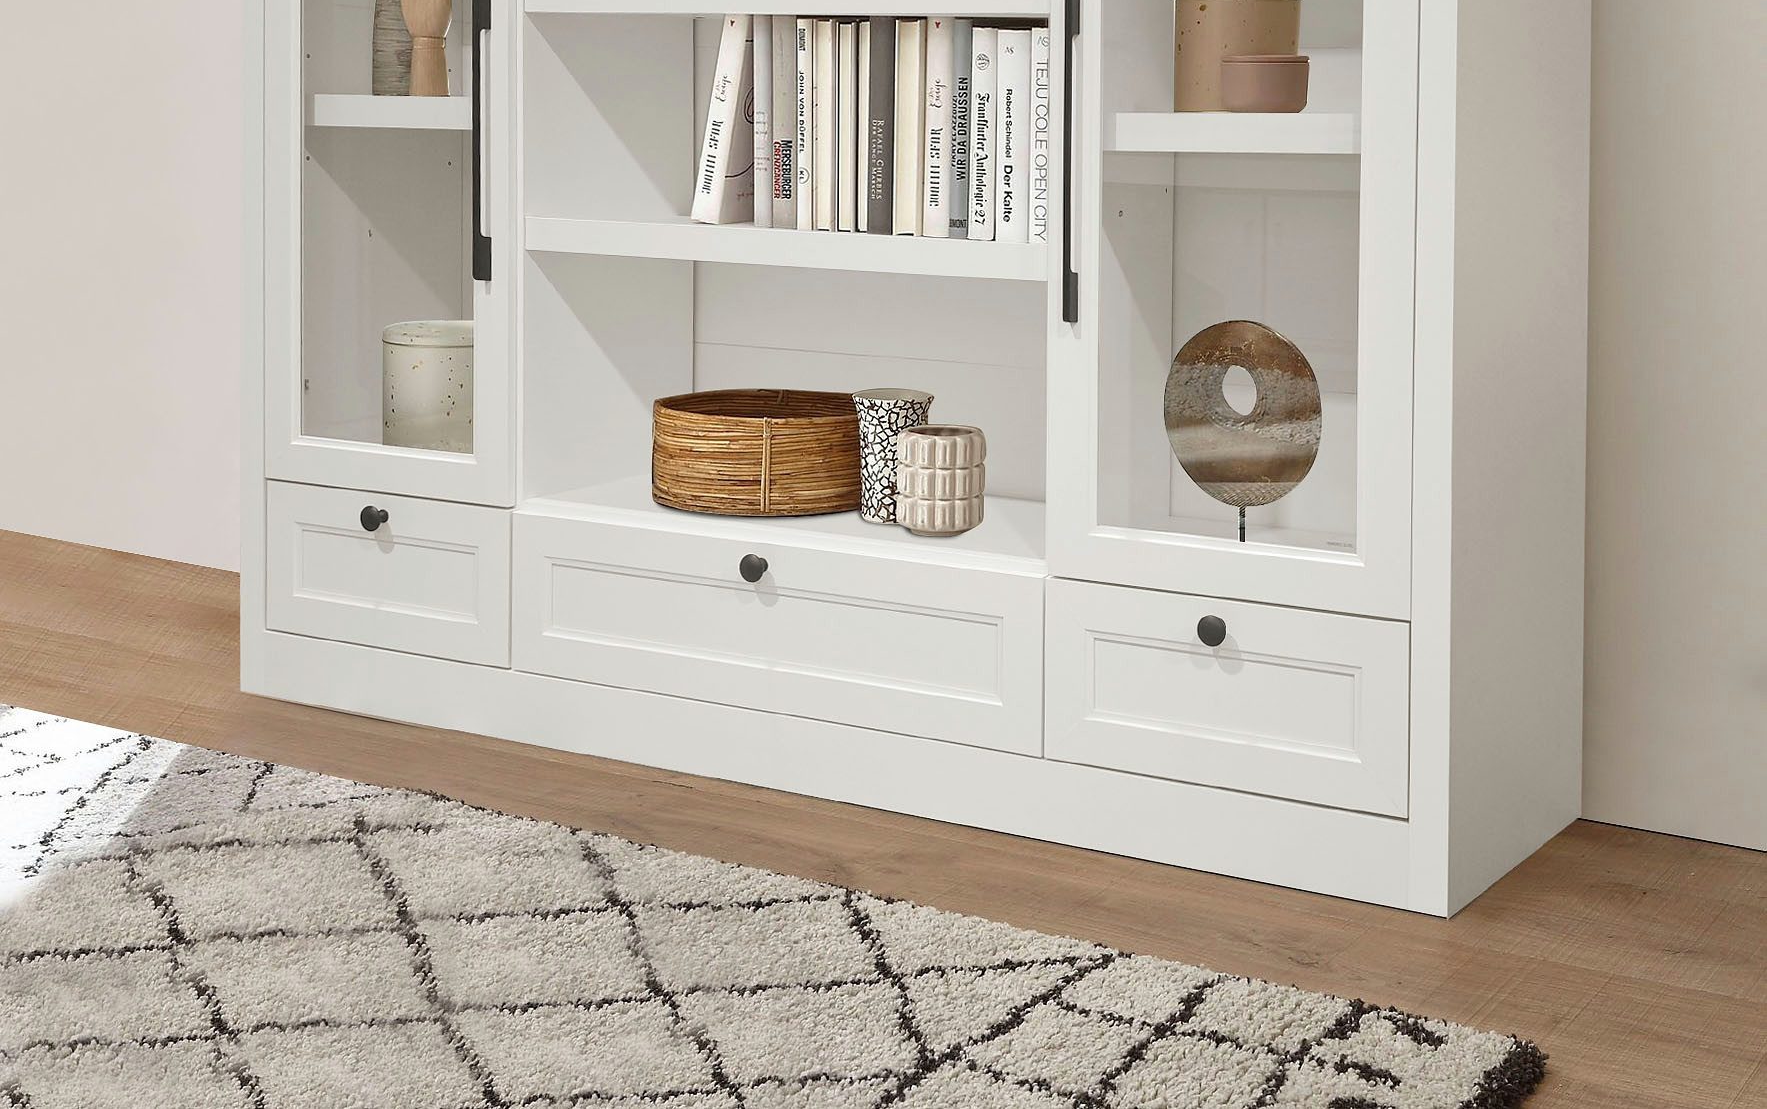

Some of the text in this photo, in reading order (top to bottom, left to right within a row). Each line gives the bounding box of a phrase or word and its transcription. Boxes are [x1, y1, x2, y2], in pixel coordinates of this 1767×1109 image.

[1035, 58, 1049, 99] TEJU
[876, 119, 885, 155] RAFAEL
[956, 77, 969, 181] WIR DA DRAUSSEN
[1004, 88, 1014, 159] Robert Schindel
[1034, 104, 1049, 150] COLE
[781, 140, 793, 200] MERSEBURGER
[974, 92, 990, 226] Frankfurter Anthologie 27
[1034, 154, 1049, 200] OPEN
[1002, 164, 1014, 223] Der Kalte
[1033, 204, 1048, 241] CITY
